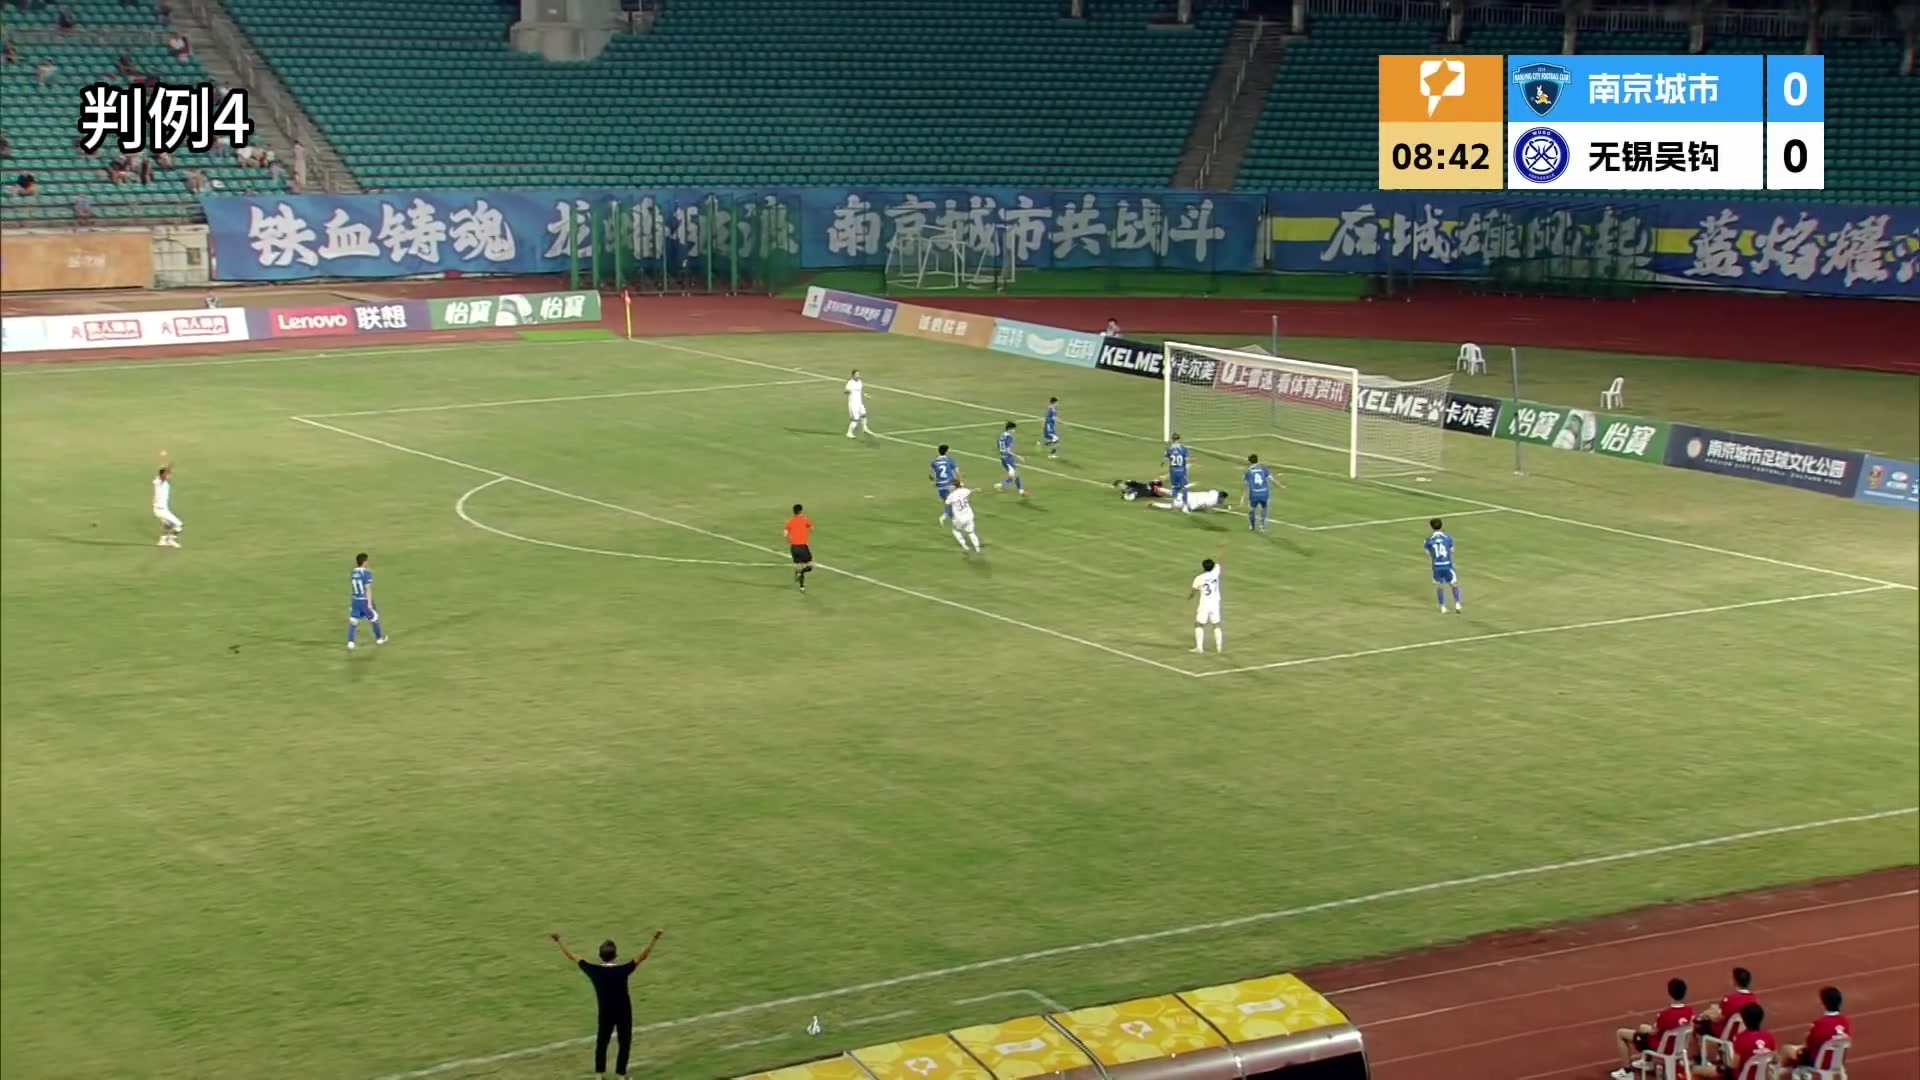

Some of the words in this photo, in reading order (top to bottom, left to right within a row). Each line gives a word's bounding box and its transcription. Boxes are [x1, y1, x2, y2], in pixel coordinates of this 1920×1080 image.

[248, 198, 517, 266] 铁血铸魂
[826, 194, 1226, 263] 南京城市共战斗
[278, 313, 347, 331] Lenovo
[355, 305, 406, 330] 联想
[1100, 345, 1163, 373] KELME
[1358, 387, 1432, 420] KELME
[1445, 402, 1495, 429] 卡尔美
[1170, 455, 1183, 467] 20
[1707, 440, 1846, 477] 南京城市足球文化公园
[939, 465, 947, 478] 2
[1254, 473, 1263, 485] 4
[1432, 543, 1448, 558] 14
[352, 579, 364, 594] 11
